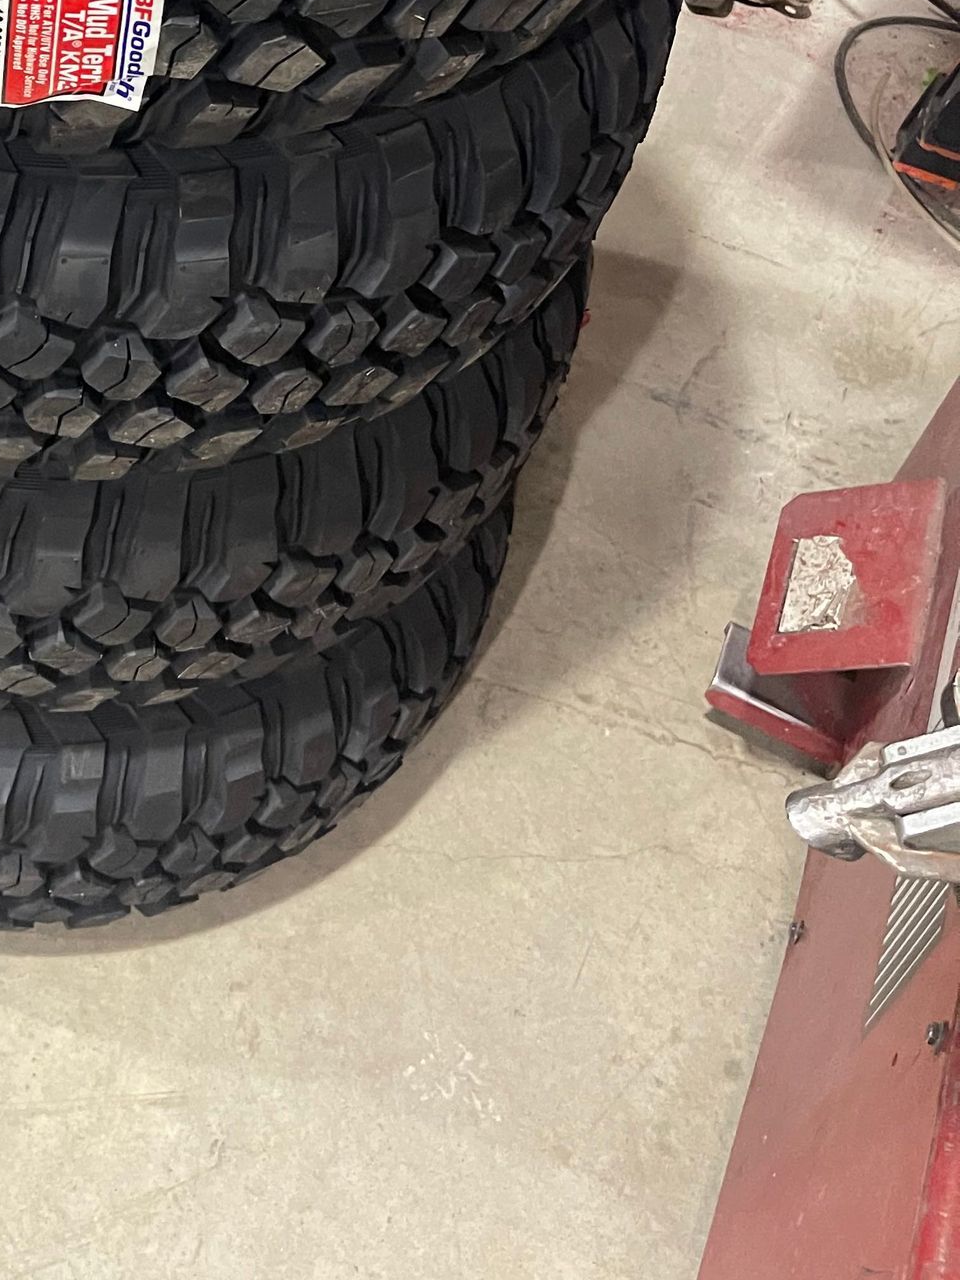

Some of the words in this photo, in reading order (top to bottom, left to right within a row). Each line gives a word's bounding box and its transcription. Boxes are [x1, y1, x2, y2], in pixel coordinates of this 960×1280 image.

[17, 3, 26, 18] Not
[30, 4, 40, 20] NHS
[43, 4, 54, 19] For
[16, 19, 26, 33] DOT
[29, 23, 39, 35] Not
[27, 37, 37, 46] for
[40, 20, 53, 53] ATV/UTV
[12, 35, 24, 70] Approved
[23, 47, 36, 74] Highway
[39, 54, 49, 68] Use
[36, 69, 47, 85] Only
[23, 75, 33, 97] Service
